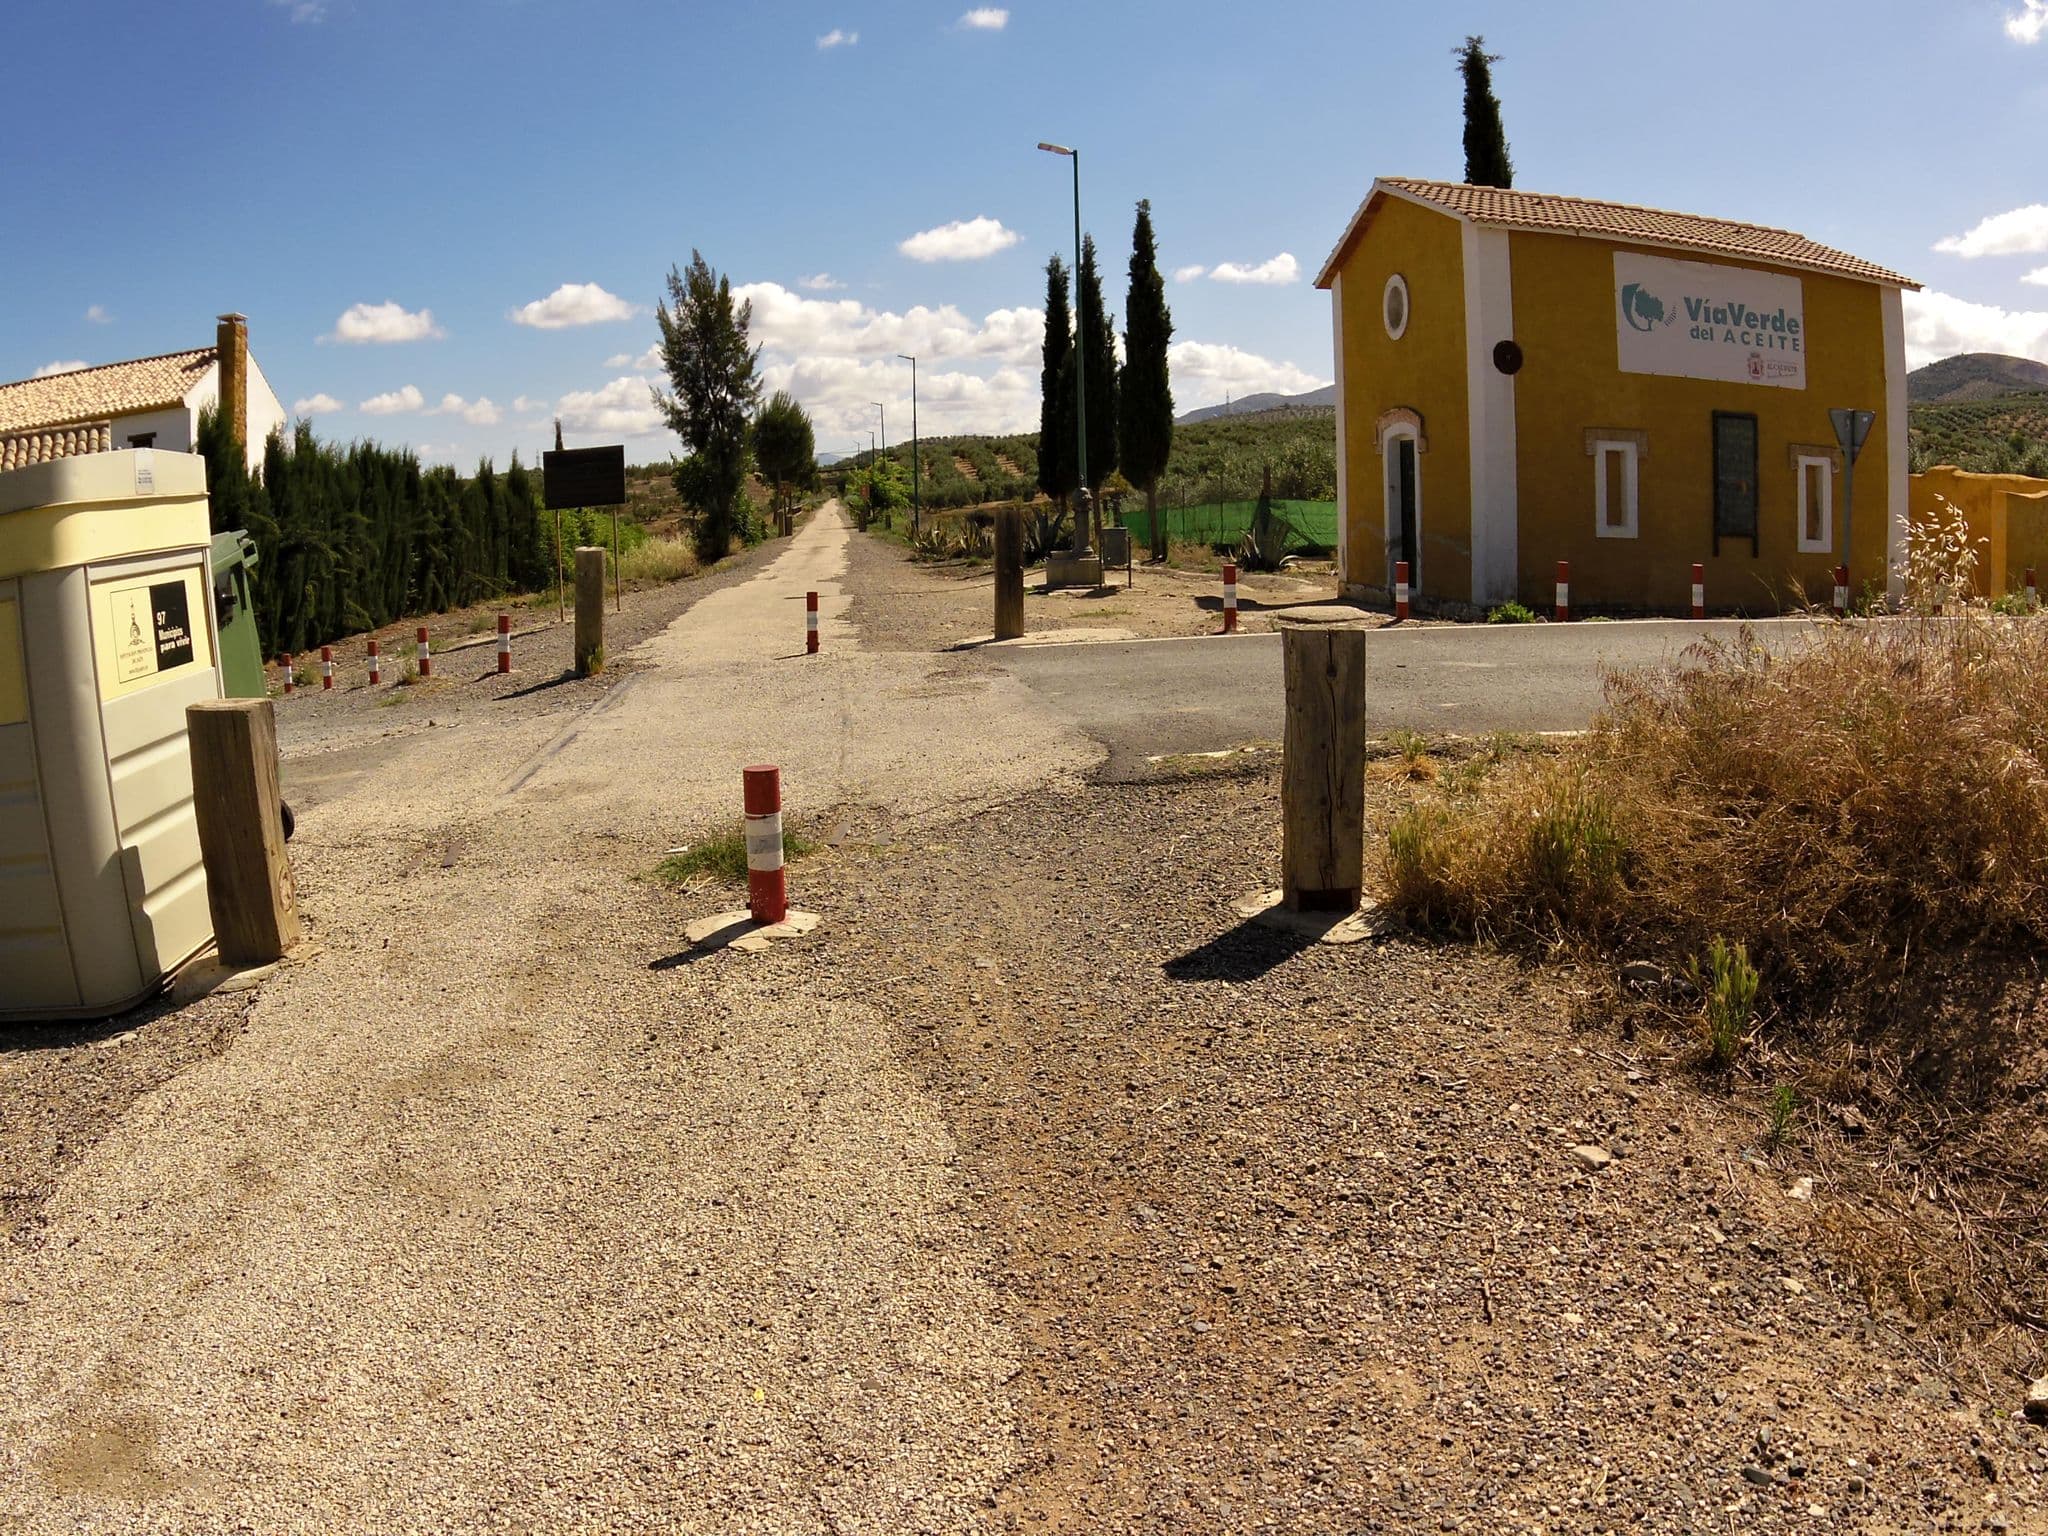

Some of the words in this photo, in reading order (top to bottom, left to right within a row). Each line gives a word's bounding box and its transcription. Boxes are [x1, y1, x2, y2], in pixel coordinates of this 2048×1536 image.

[1690, 325, 1714, 341] del
[1723, 329, 1800, 352] ACEITE
[156, 611, 166, 626] 97
[160, 641, 176, 654] para
[176, 636, 190, 647] vivir
